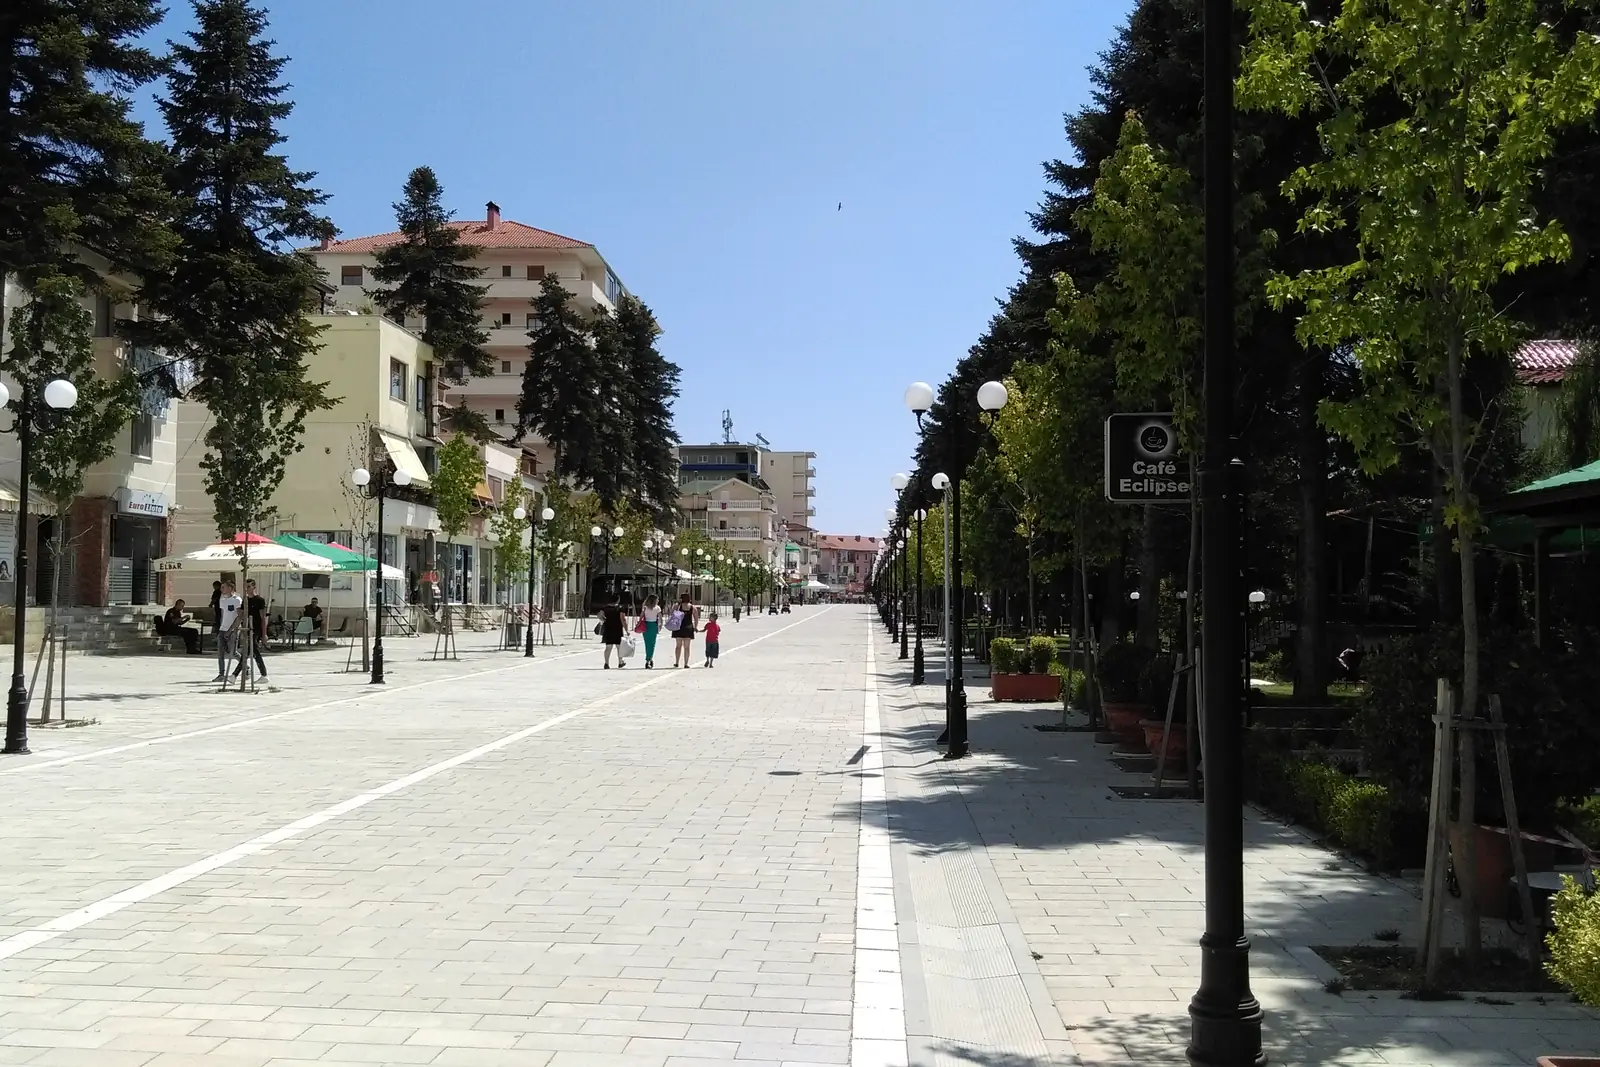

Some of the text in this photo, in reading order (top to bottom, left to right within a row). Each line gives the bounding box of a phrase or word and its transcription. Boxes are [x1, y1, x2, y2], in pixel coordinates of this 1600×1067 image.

[1132, 461, 1177, 475] Café
[1119, 478, 1189, 496] Eclipse
[129, 501, 145, 511] Euro
